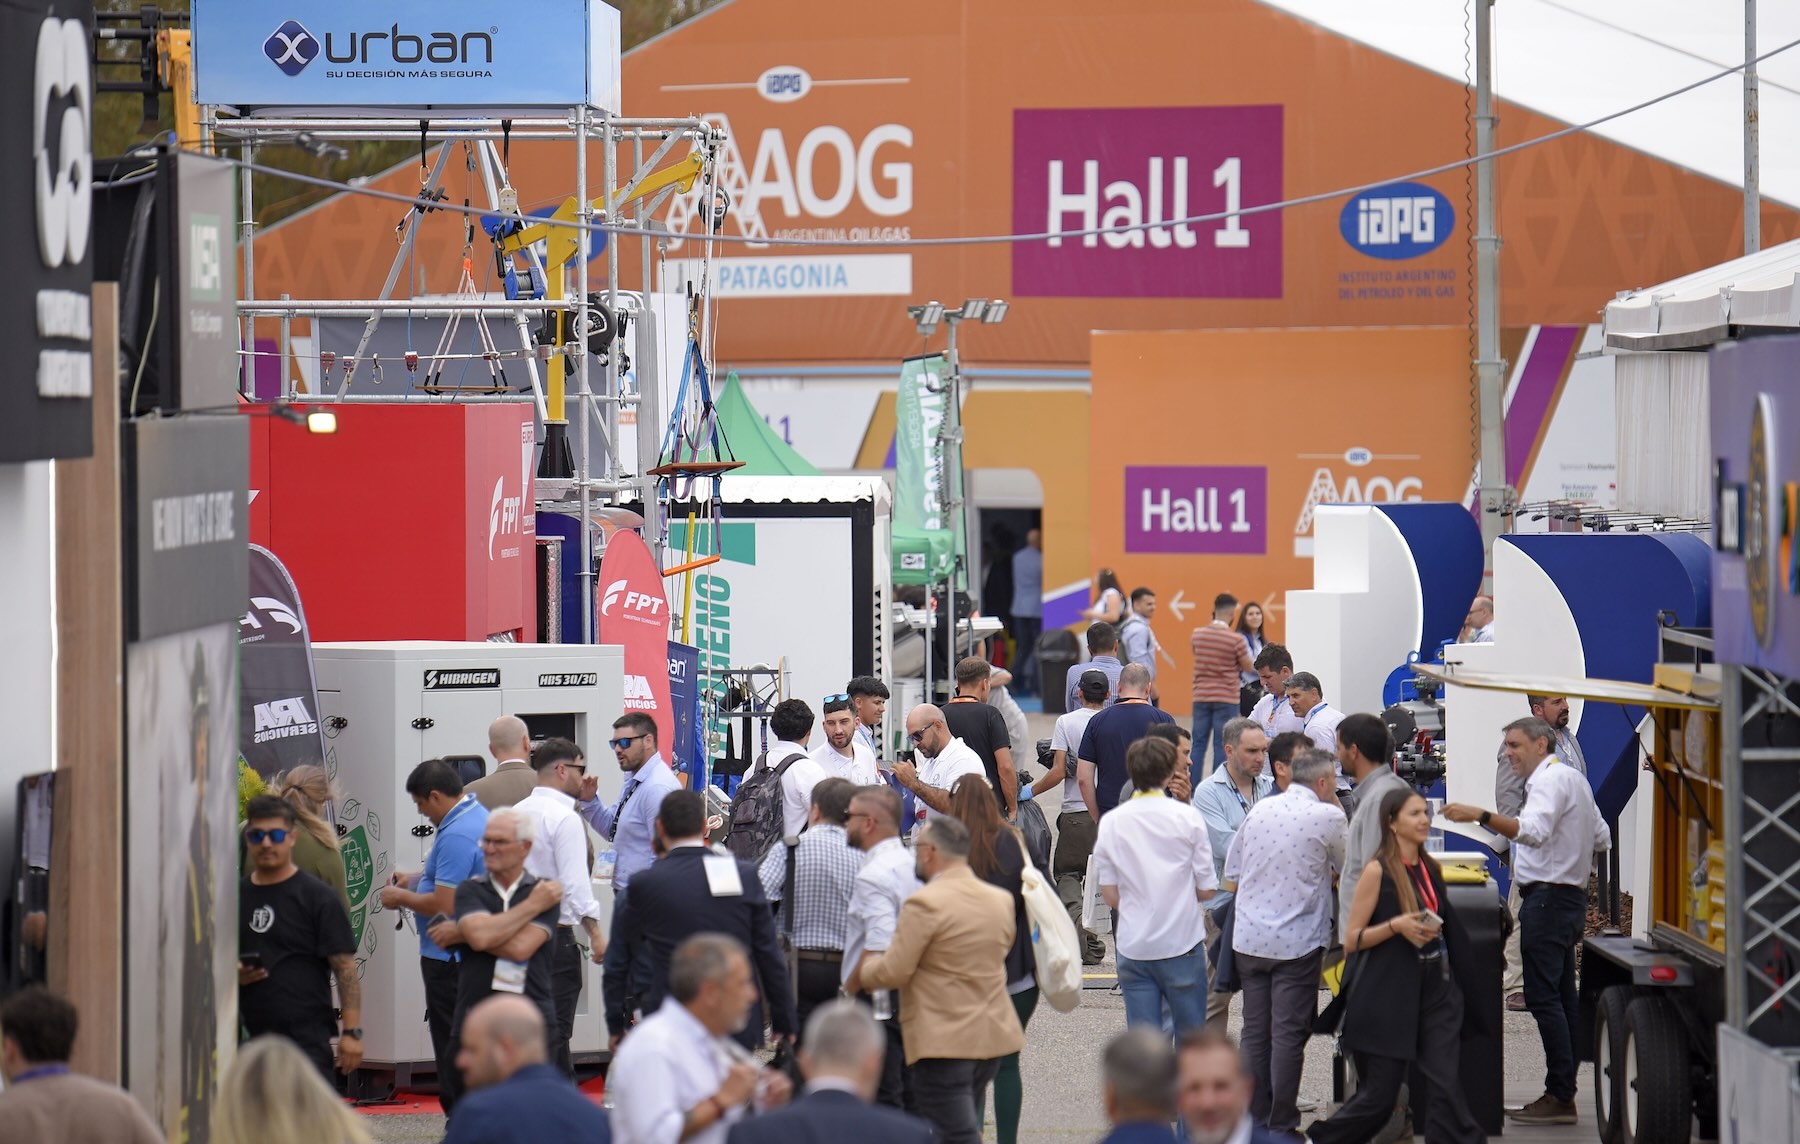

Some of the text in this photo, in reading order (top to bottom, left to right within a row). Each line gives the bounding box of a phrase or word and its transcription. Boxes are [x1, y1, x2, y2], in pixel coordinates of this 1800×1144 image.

[325, 22, 493, 64] urban
[346, 68, 405, 78] DECISIÓN
[408, 69, 438, 78] MÁS
[440, 70, 493, 78] SEGURA
[744, 123, 913, 218] AOG
[1047, 156, 1250, 249] Hall 1
[773, 228, 848, 245] ARGENTINA
[718, 262, 849, 291] PATAGONIA
[1338, 269, 1456, 283] INSTITUTO ARGENTINO
[501, 496, 520, 535] FPT
[1142, 487, 1250, 533] Hall 1
[623, 591, 663, 615] FPT
[438, 672, 498, 685] HIBRIGEN
[539, 673, 597, 686] HBS 30/30
